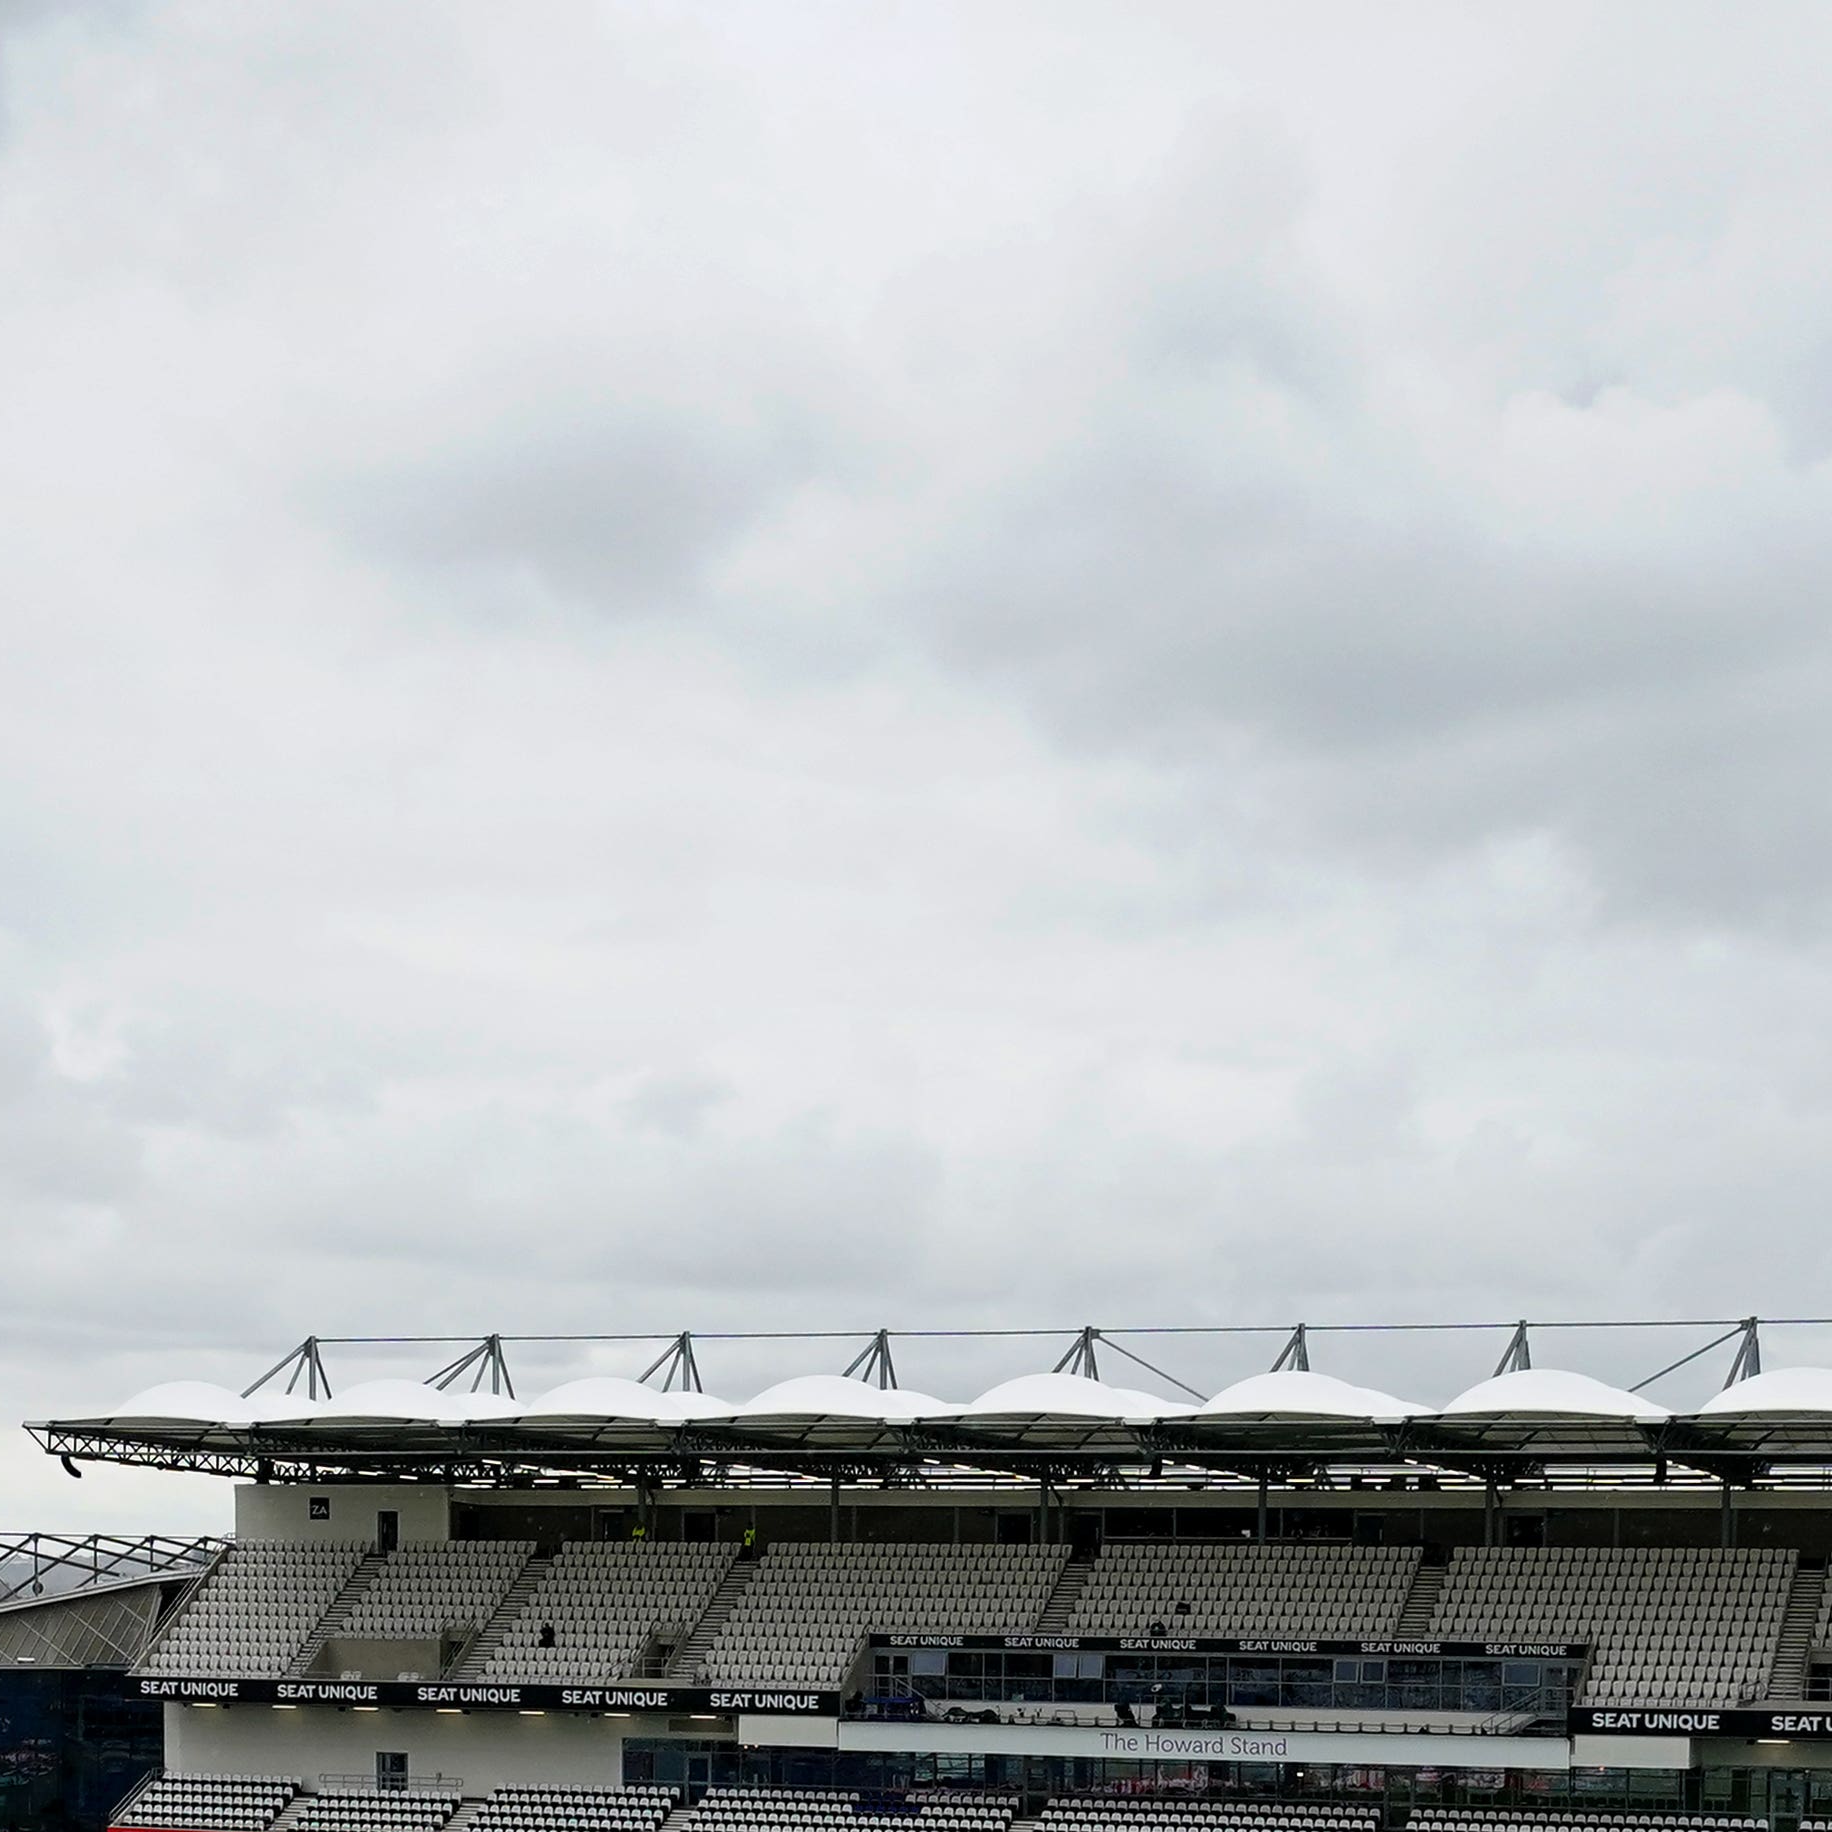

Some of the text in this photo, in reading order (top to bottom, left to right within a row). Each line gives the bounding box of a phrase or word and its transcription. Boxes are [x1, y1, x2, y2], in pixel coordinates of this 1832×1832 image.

[890, 1635, 964, 1647] SEAT UNIQUE
[1119, 1638, 1196, 1651] SEAT UNIQUE
[1239, 1640, 1317, 1653] SEAT UNIQUE
[140, 1681, 239, 1698] SEAT UNIQUE
[277, 1684, 378, 1701] SEAT UNIQUE
[418, 1687, 521, 1704] SEAT UNIQUE
[1592, 1712, 1720, 1731] SEAT UNIQUE
[1100, 1733, 1288, 1756] The Howard Stand
